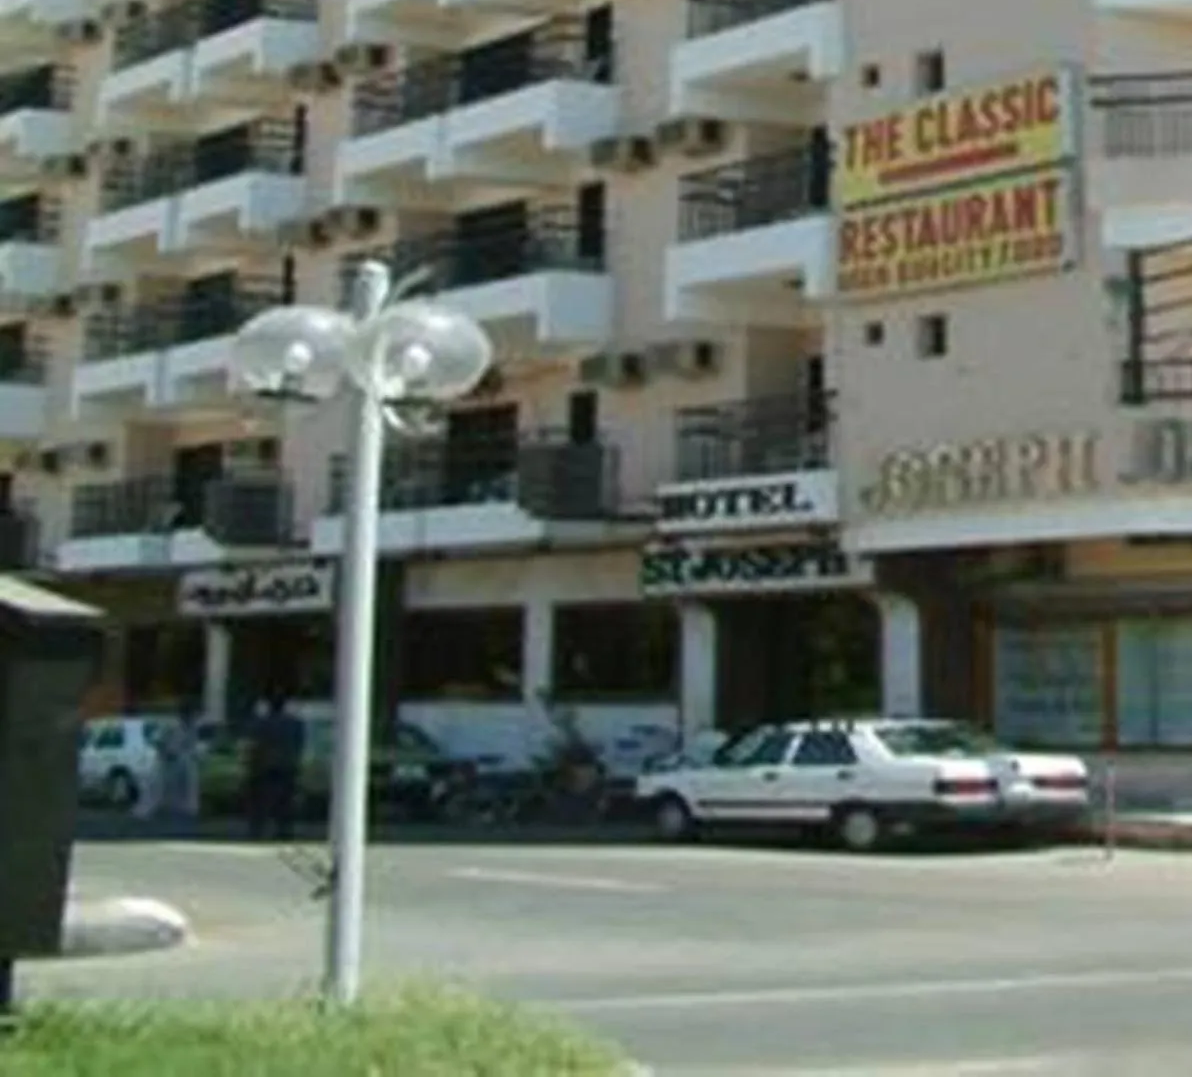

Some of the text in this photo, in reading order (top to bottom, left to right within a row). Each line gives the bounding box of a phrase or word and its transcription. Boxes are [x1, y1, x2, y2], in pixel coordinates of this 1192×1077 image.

[842, 75, 1061, 171] THE CLASSIC
[839, 178, 1061, 265] RESTAURANT
[661, 481, 814, 520] HOTEL
